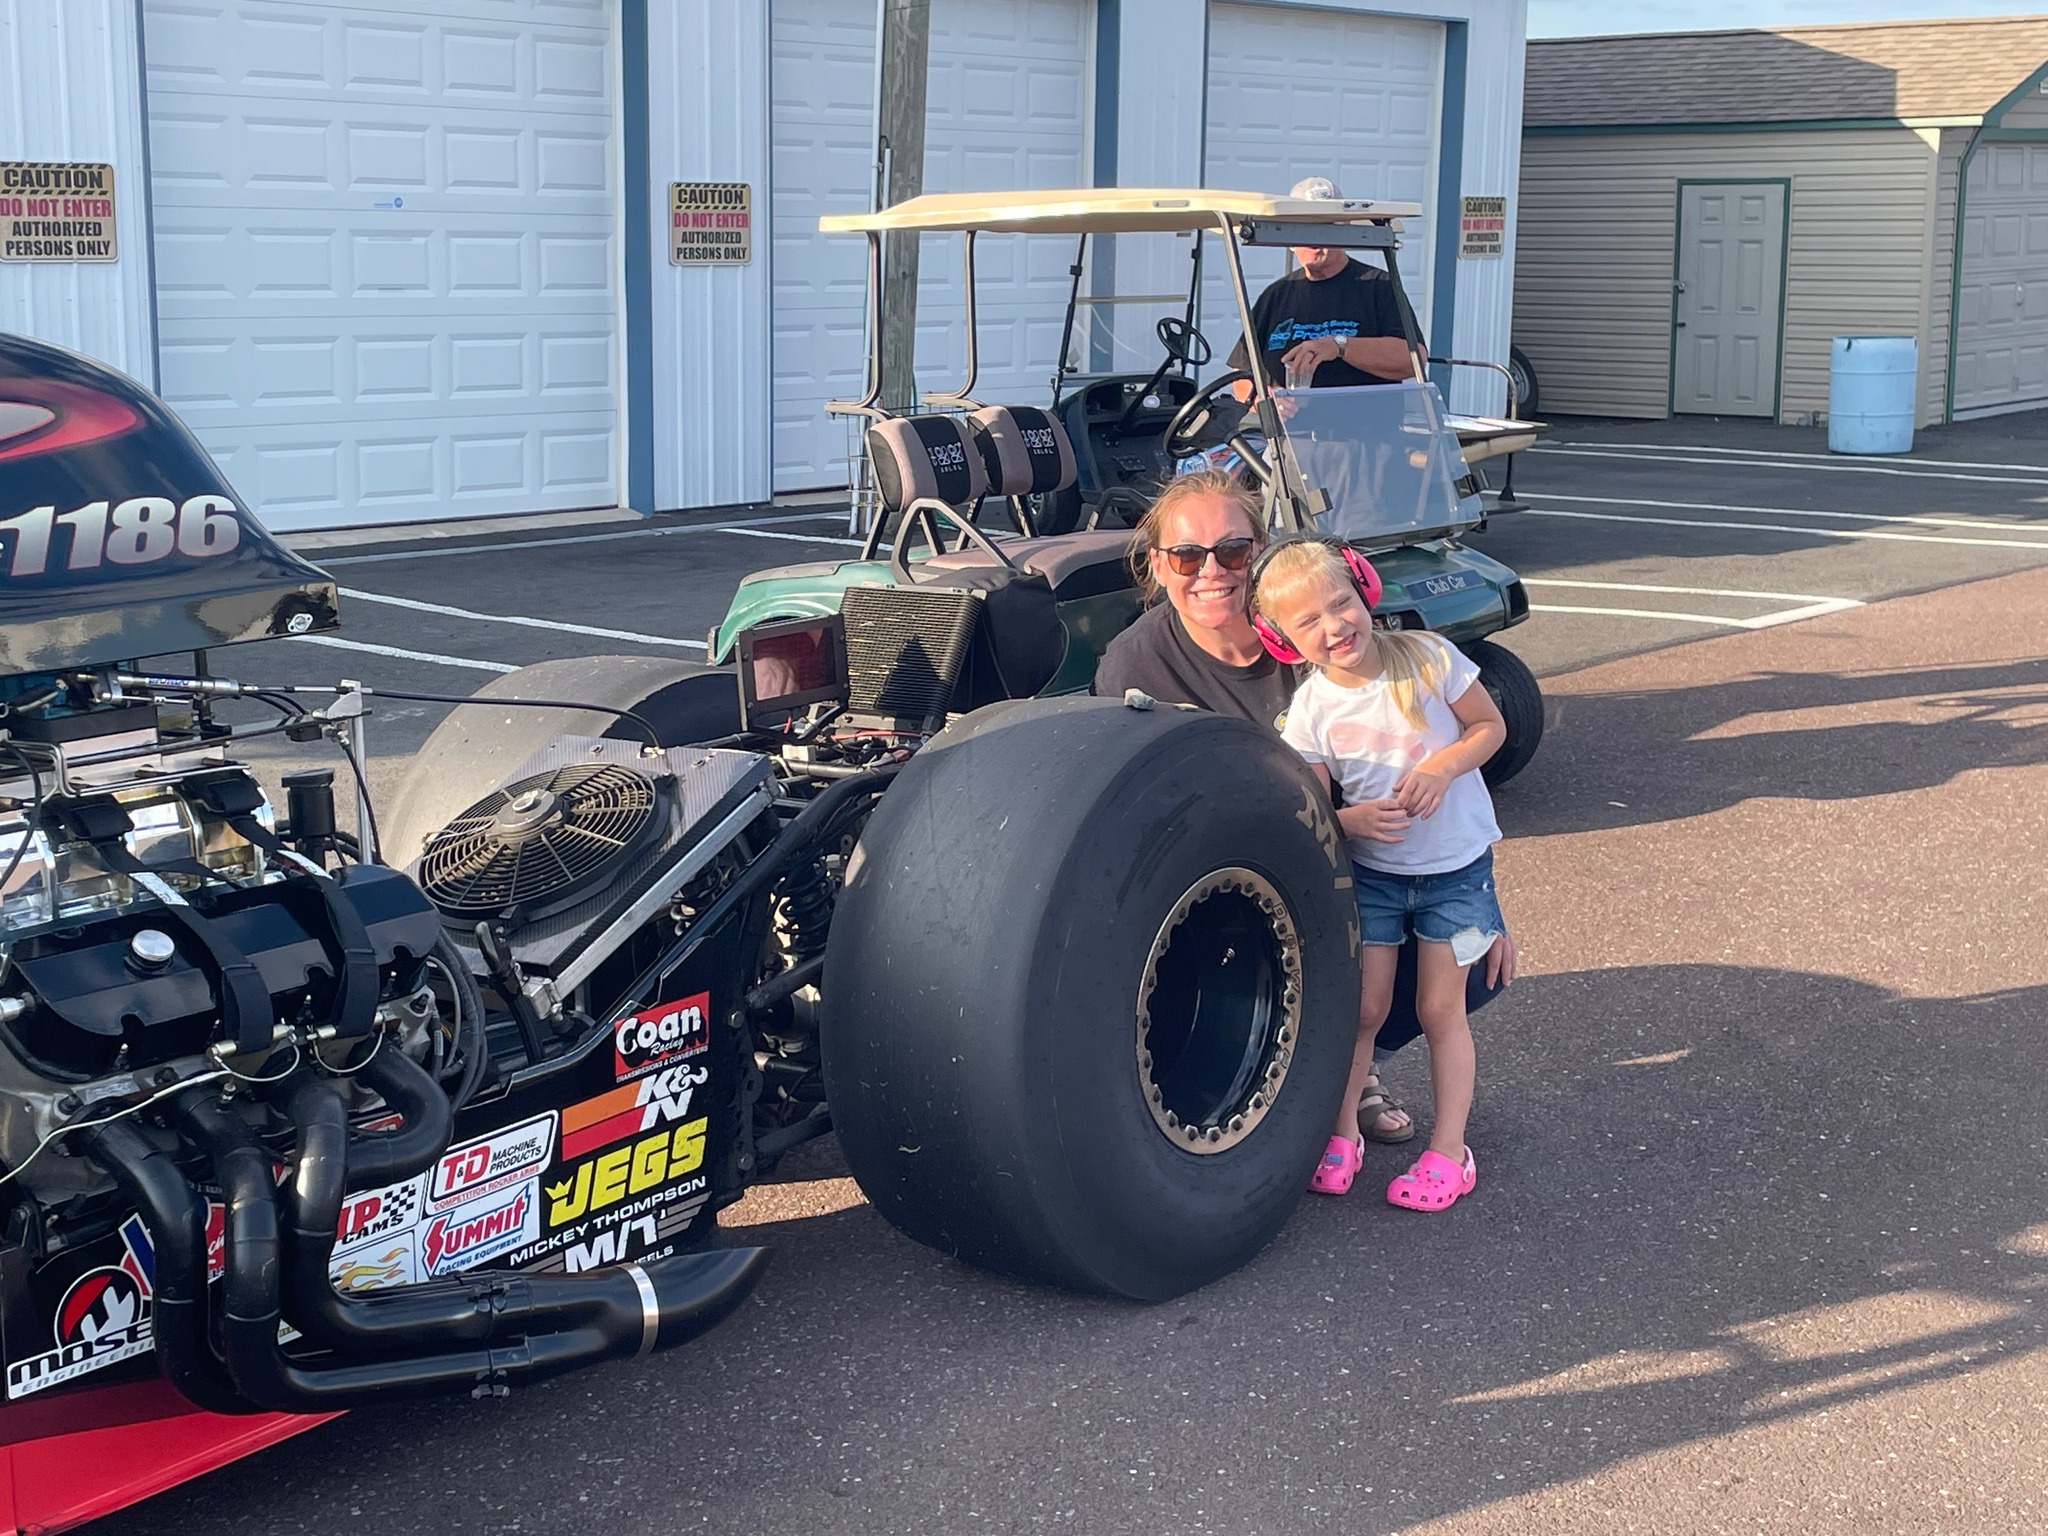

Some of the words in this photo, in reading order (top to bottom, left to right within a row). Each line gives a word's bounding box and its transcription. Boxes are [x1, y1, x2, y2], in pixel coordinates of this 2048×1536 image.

[4, 168, 103, 188] CAUTION
[677, 188, 744, 204] CAUTION
[0, 198, 23, 217] DO
[27, 198, 59, 217] NOT
[63, 198, 112, 218] ENTER
[1465, 201, 1502, 213] CAUTION
[12, 221, 103, 237] AUTHORIZED
[674, 212, 689, 228] DO
[692, 212, 714, 228] NOT
[716, 212, 749, 228] ENTER
[681, 231, 742, 244] AUTHORIZED
[5, 240, 73, 256] PERSONS
[76, 240, 111, 256] ONLY
[676, 247, 722, 260] PERSONS
[723, 247, 748, 260] ONLY
[0, 494, 241, 578] 1186
[1425, 578, 1450, 595] Club
[1448, 575, 1467, 589] Car
[616, 1005, 702, 1055] Coan
[649, 1037, 684, 1057] Racing
[616, 1060, 663, 1084] TRANSMISSIONS
[669, 1044, 709, 1064] CONVERTERS
[443, 1144, 491, 1191] T&D
[492, 1136, 538, 1162] MACHINE
[489, 1144, 542, 1174] PRODUCTS
[549, 1116, 707, 1227] JEGS
[433, 1185, 487, 1211] COMPETITION
[488, 1173, 518, 1191] ROCKER
[519, 1164, 540, 1178] ARMS
[341, 1213, 405, 1245] CAMS
[509, 1221, 589, 1266] MICKEY
[593, 1175, 707, 1230] THOMPSON
[439, 1255, 472, 1275] RACING
[474, 1234, 523, 1261] EQUIPMENT
